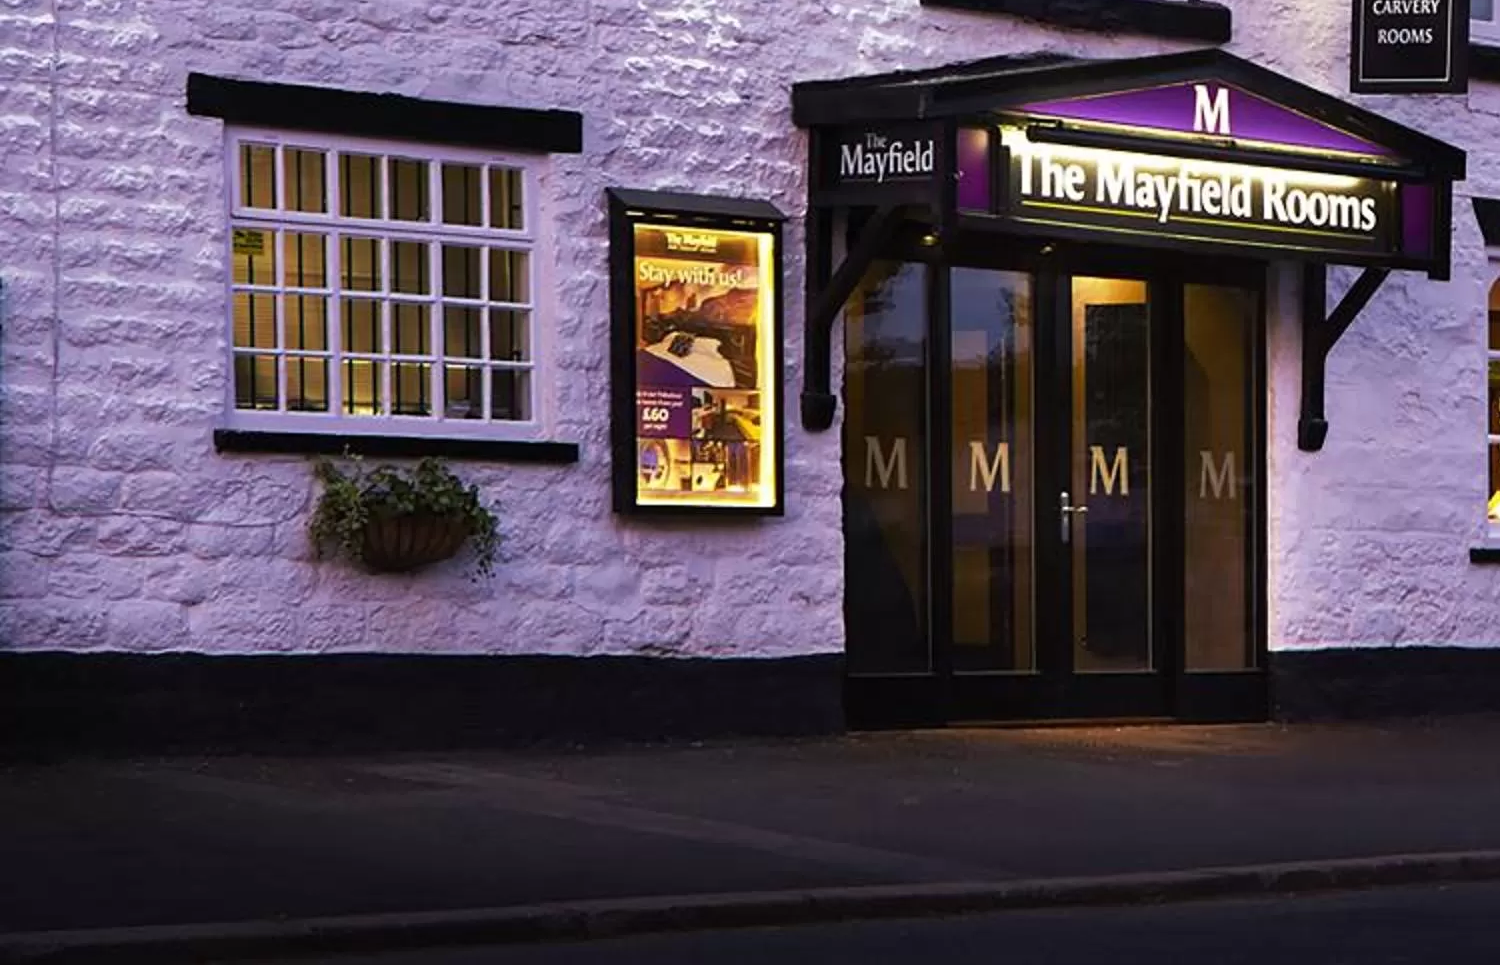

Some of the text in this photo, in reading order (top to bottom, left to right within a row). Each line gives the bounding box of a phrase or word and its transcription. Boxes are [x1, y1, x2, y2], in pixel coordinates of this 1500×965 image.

[1372, 0, 1440, 15] CARVERY
[1377, 28, 1433, 44] ROOMS
[1193, 85, 1231, 134] M
[840, 140, 934, 183] Mayfield
[864, 133, 887, 149] The
[1019, 149, 1377, 232] The Mayfield Rooms
[639, 261, 674, 288] Stay
[678, 266, 716, 286] with
[864, 436, 909, 489] M
[969, 441, 1011, 493] M
[1090, 445, 1129, 496] M
[1199, 450, 1237, 500] M
